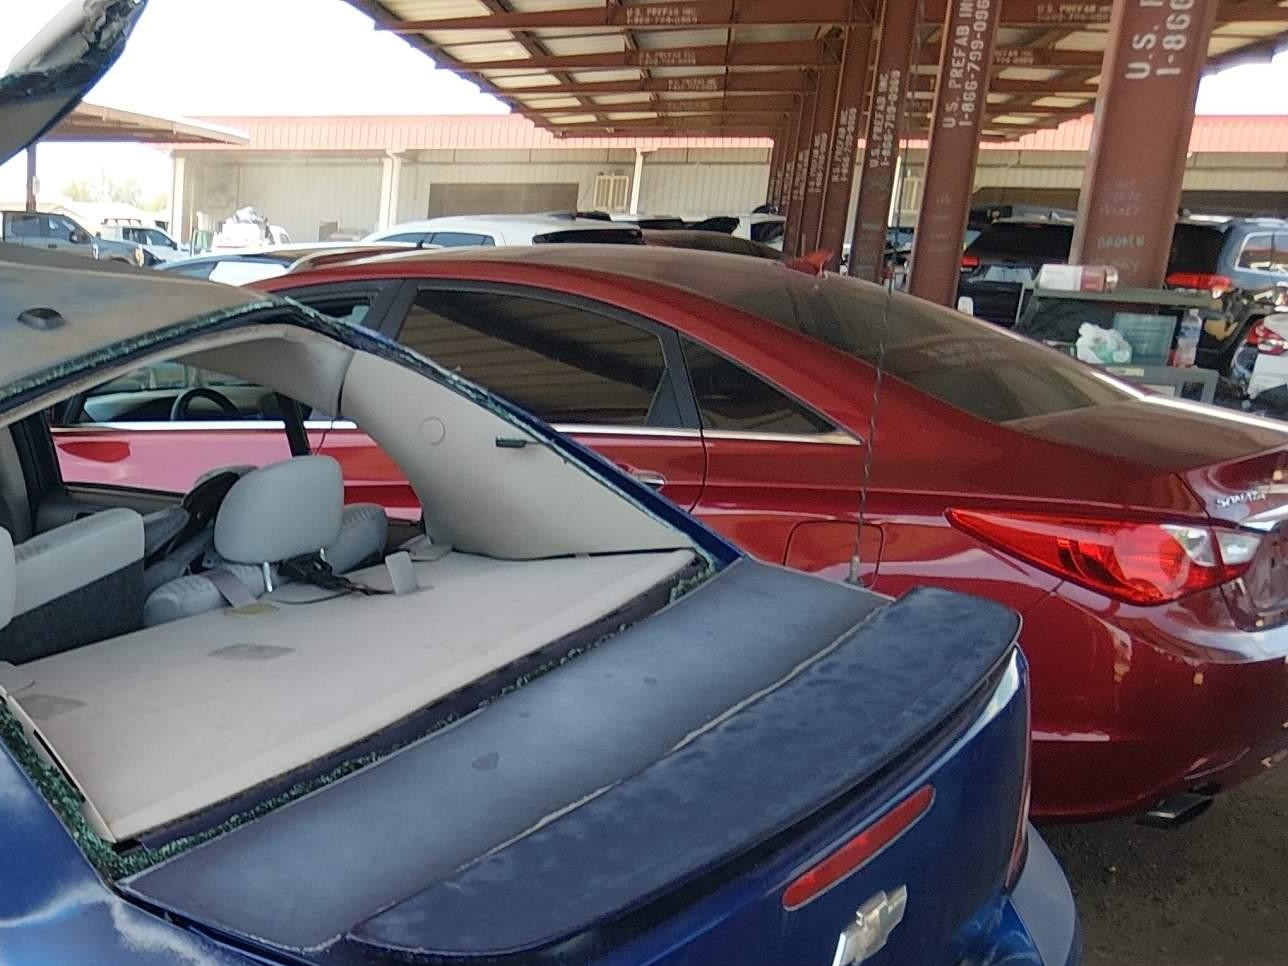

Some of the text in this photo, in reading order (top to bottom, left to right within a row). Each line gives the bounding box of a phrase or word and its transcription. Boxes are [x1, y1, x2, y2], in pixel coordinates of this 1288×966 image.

[948, 25, 970, 89] PREFAB
[1125, 25, 1159, 79] U.S.
[872, 96, 886, 141] PREFAB
[942, 96, 959, 128] U.S.
